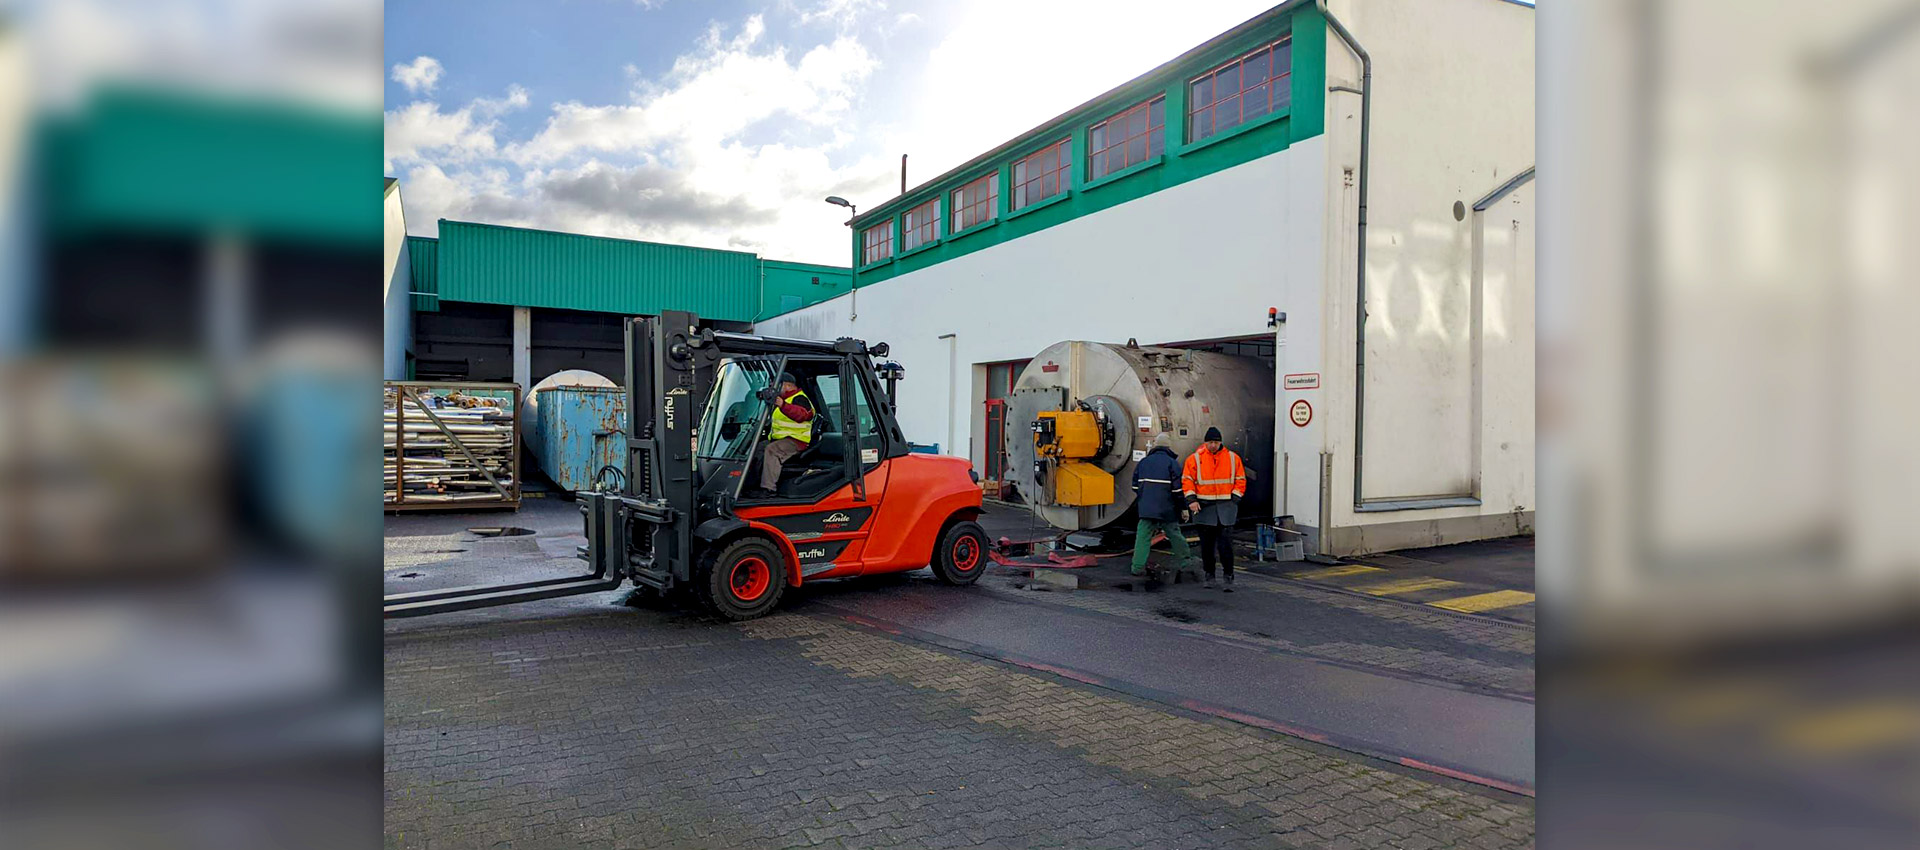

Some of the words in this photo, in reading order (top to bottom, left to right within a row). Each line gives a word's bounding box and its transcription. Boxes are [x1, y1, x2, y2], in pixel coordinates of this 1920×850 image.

[666, 387, 688, 395] Linde
[664, 396, 674, 430] suffel
[823, 512, 850, 522] Linde
[798, 548, 825, 558] suffel
